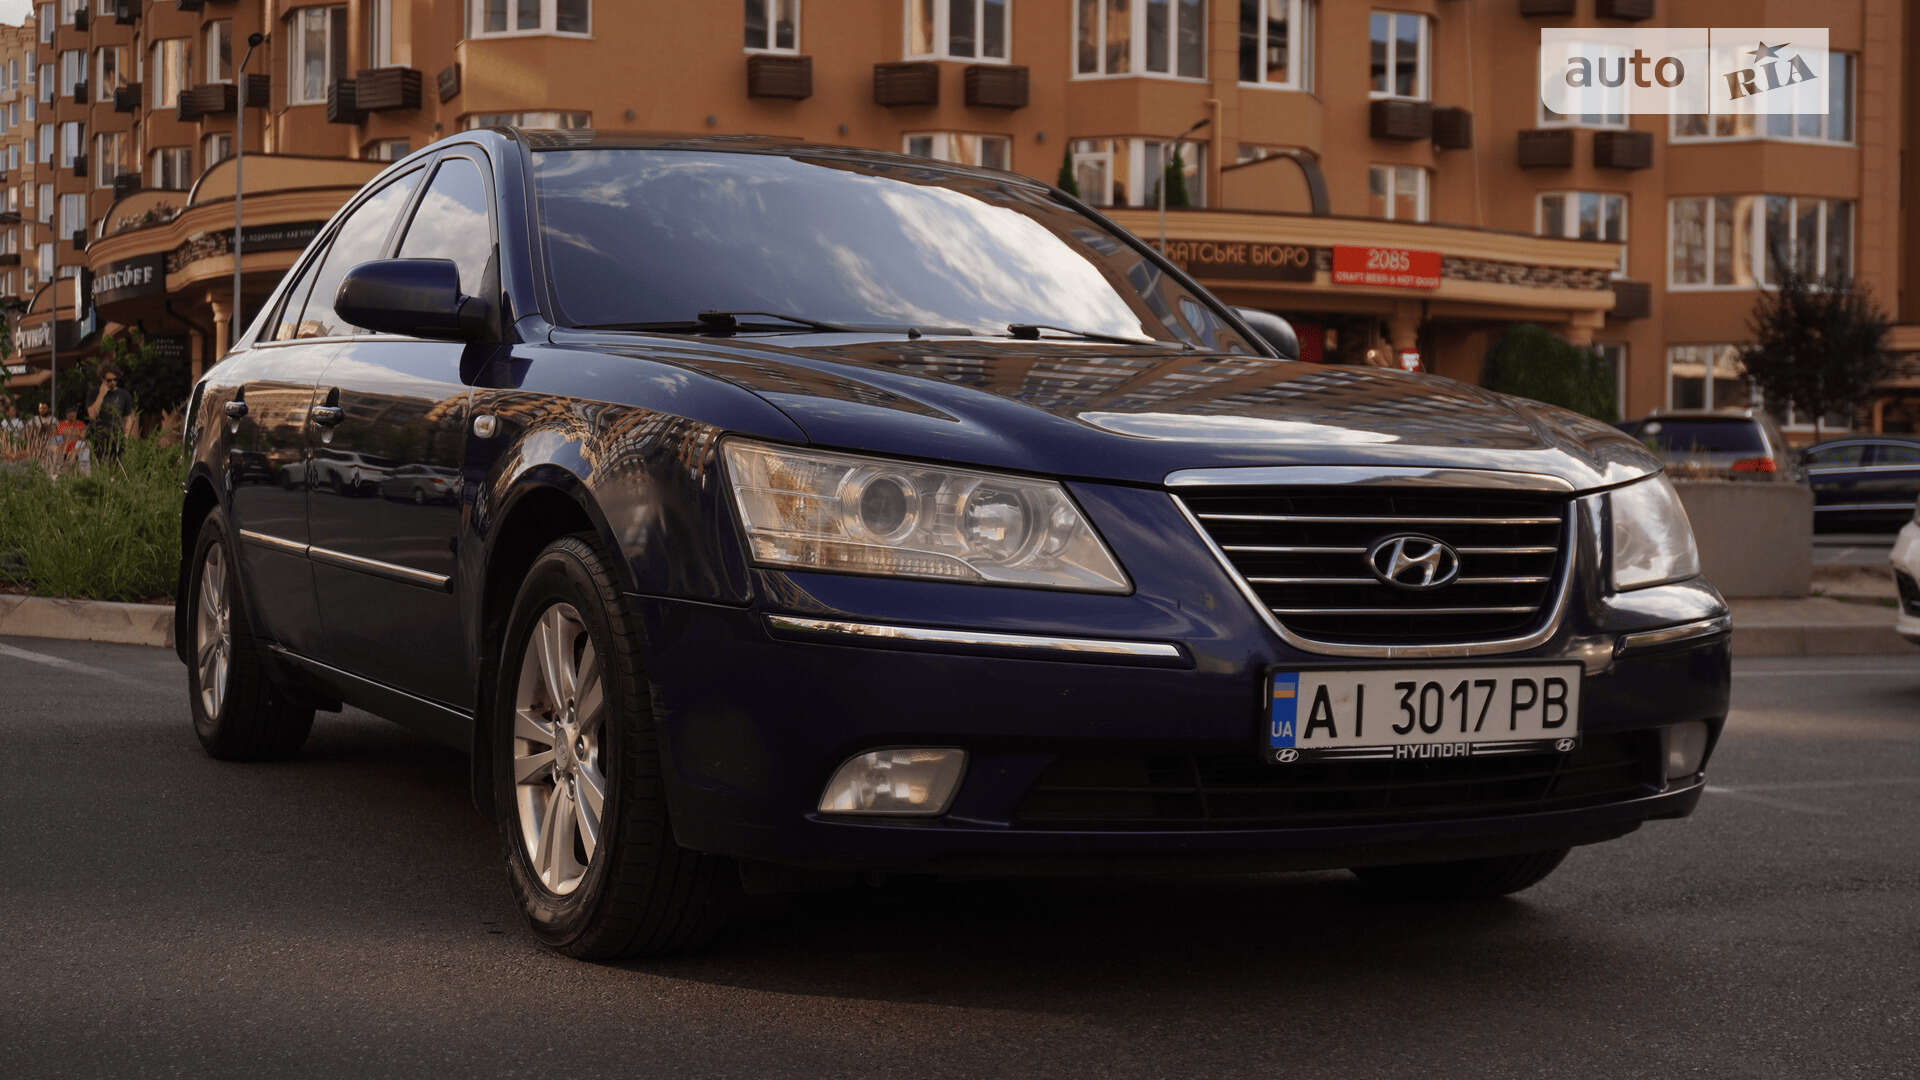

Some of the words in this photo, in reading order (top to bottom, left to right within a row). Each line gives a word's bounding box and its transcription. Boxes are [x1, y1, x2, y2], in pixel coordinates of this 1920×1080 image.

[1251, 246, 1310, 267] БЮРО
[1366, 248, 1410, 272] 2085
[1392, 678, 1497, 735] 3017
[1509, 677, 1569, 731] PB
[1271, 720, 1294, 738] UA
[1396, 742, 1470, 760] HYUNDAI
